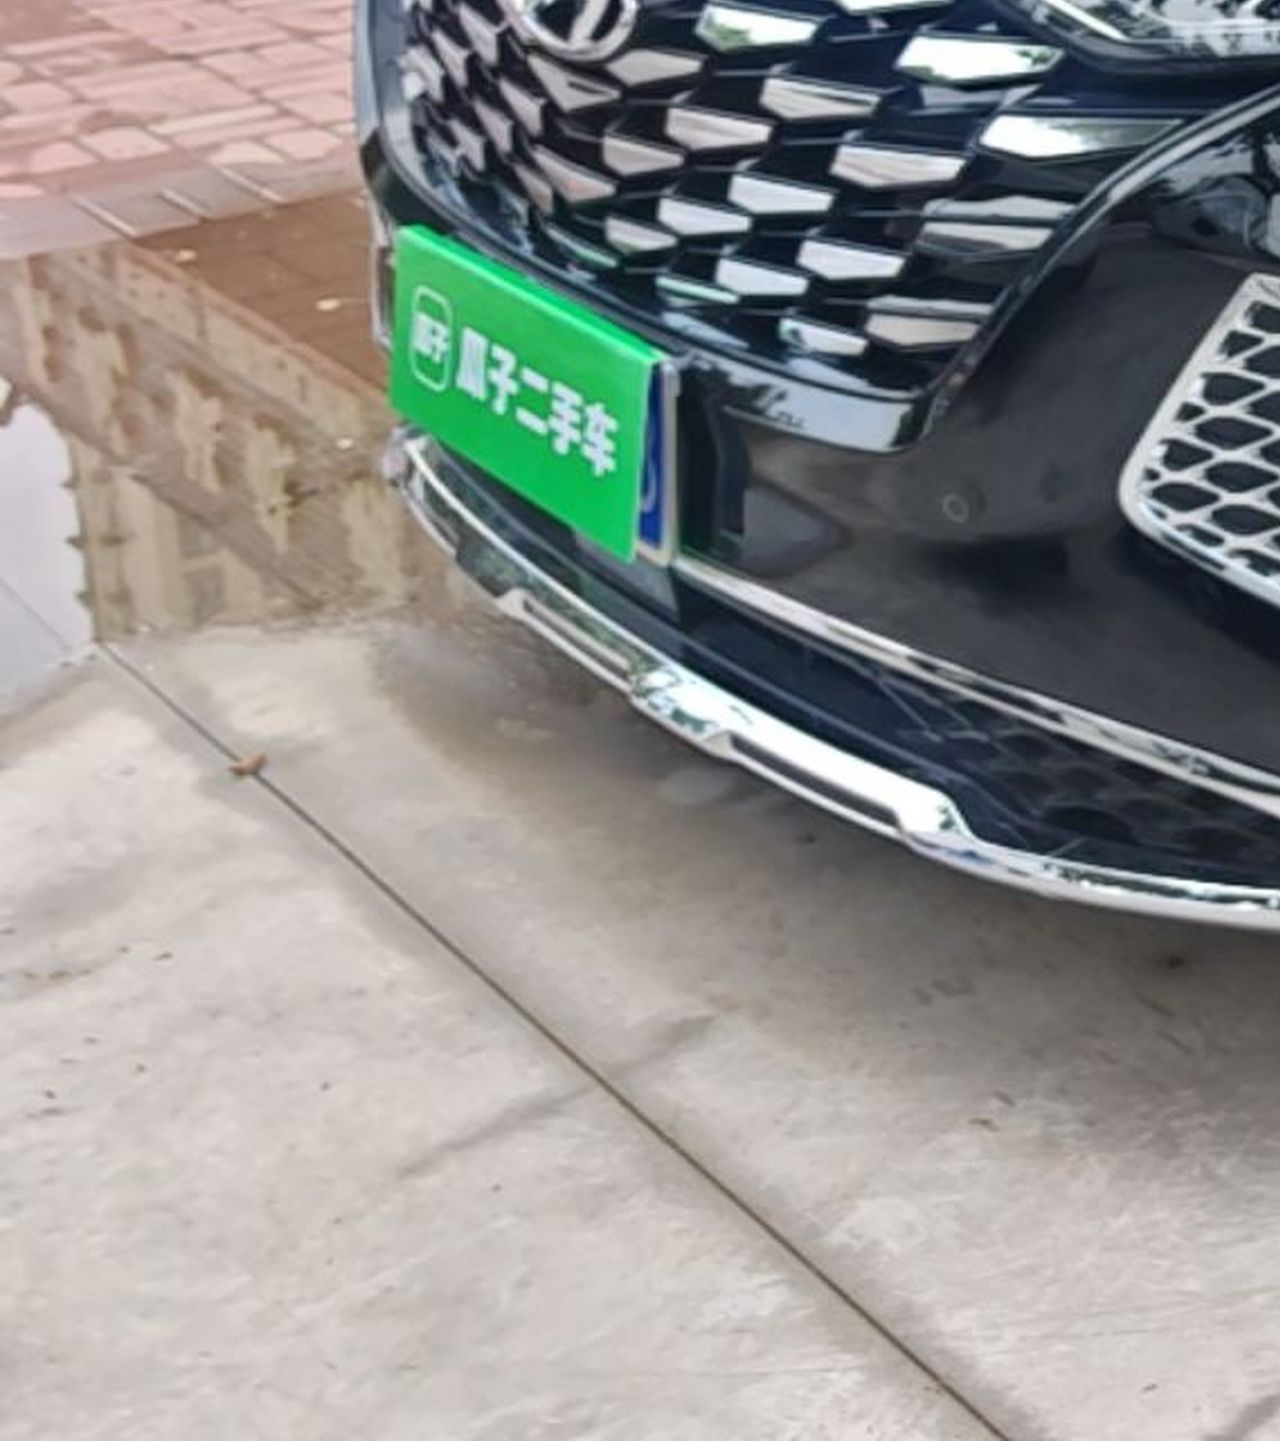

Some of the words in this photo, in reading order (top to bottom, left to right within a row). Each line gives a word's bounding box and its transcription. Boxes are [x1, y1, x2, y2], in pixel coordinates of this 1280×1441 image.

[455, 326, 619, 477] 瓜子二手车
